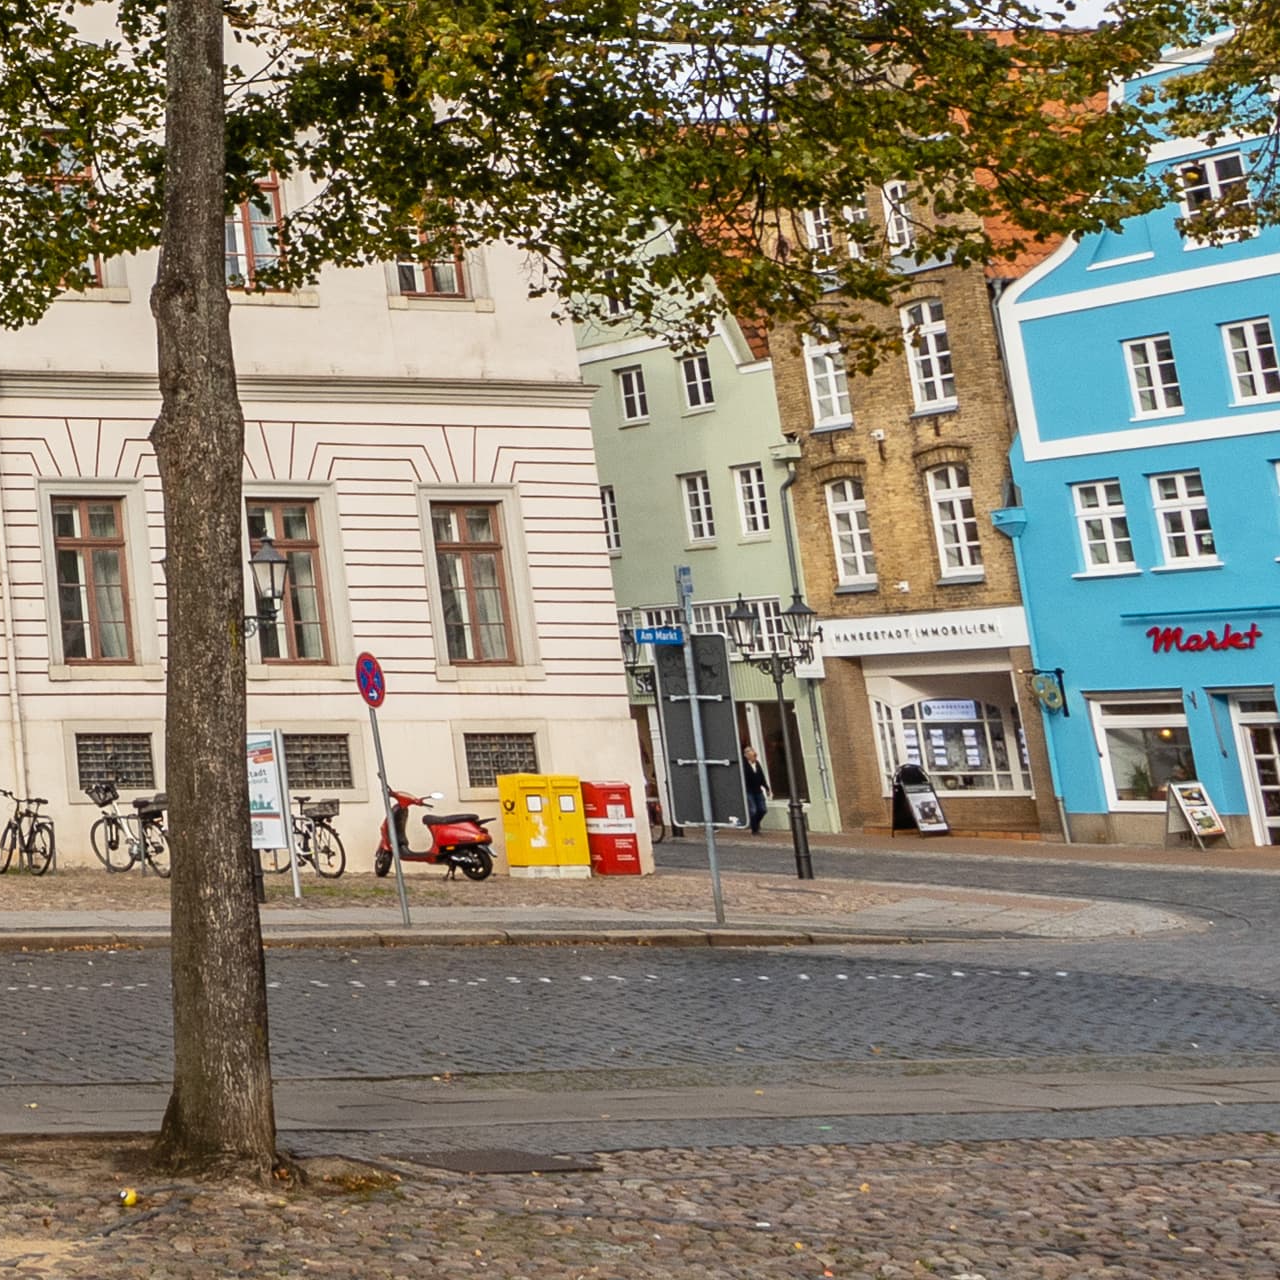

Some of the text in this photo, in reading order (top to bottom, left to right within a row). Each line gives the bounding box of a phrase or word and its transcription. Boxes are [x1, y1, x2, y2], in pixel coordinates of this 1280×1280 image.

[641, 631, 678, 640] Am Markt
[834, 623, 996, 643] HANSESTADT IMMOBILIEN
[1146, 623, 1263, 653] Markt
